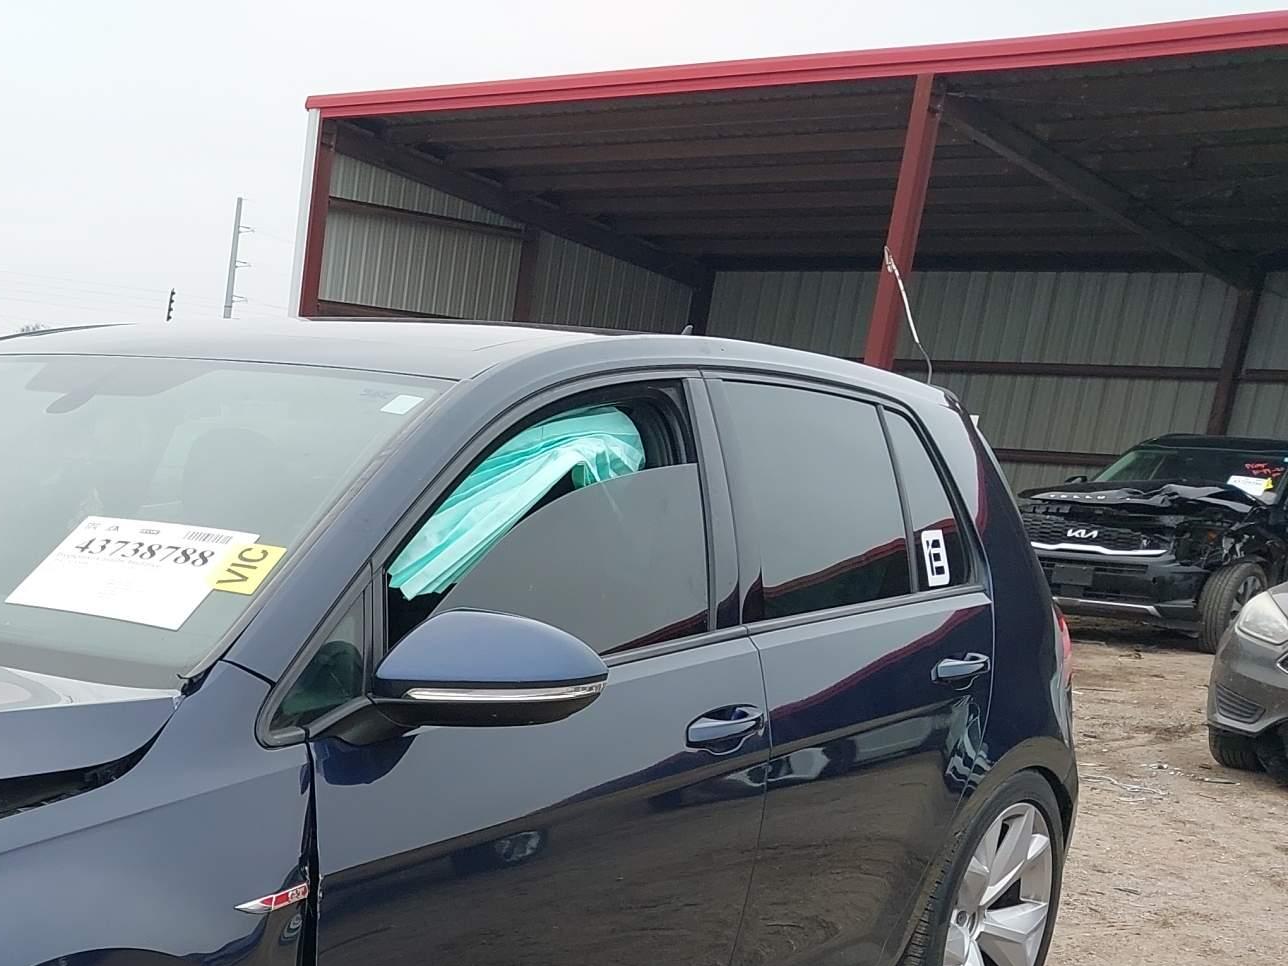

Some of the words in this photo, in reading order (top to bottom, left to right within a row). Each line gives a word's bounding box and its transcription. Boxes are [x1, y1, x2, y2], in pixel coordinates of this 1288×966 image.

[1067, 528, 1098, 538] KIA
[74, 537, 215, 567] 43738788
[215, 547, 268, 584] VIC
